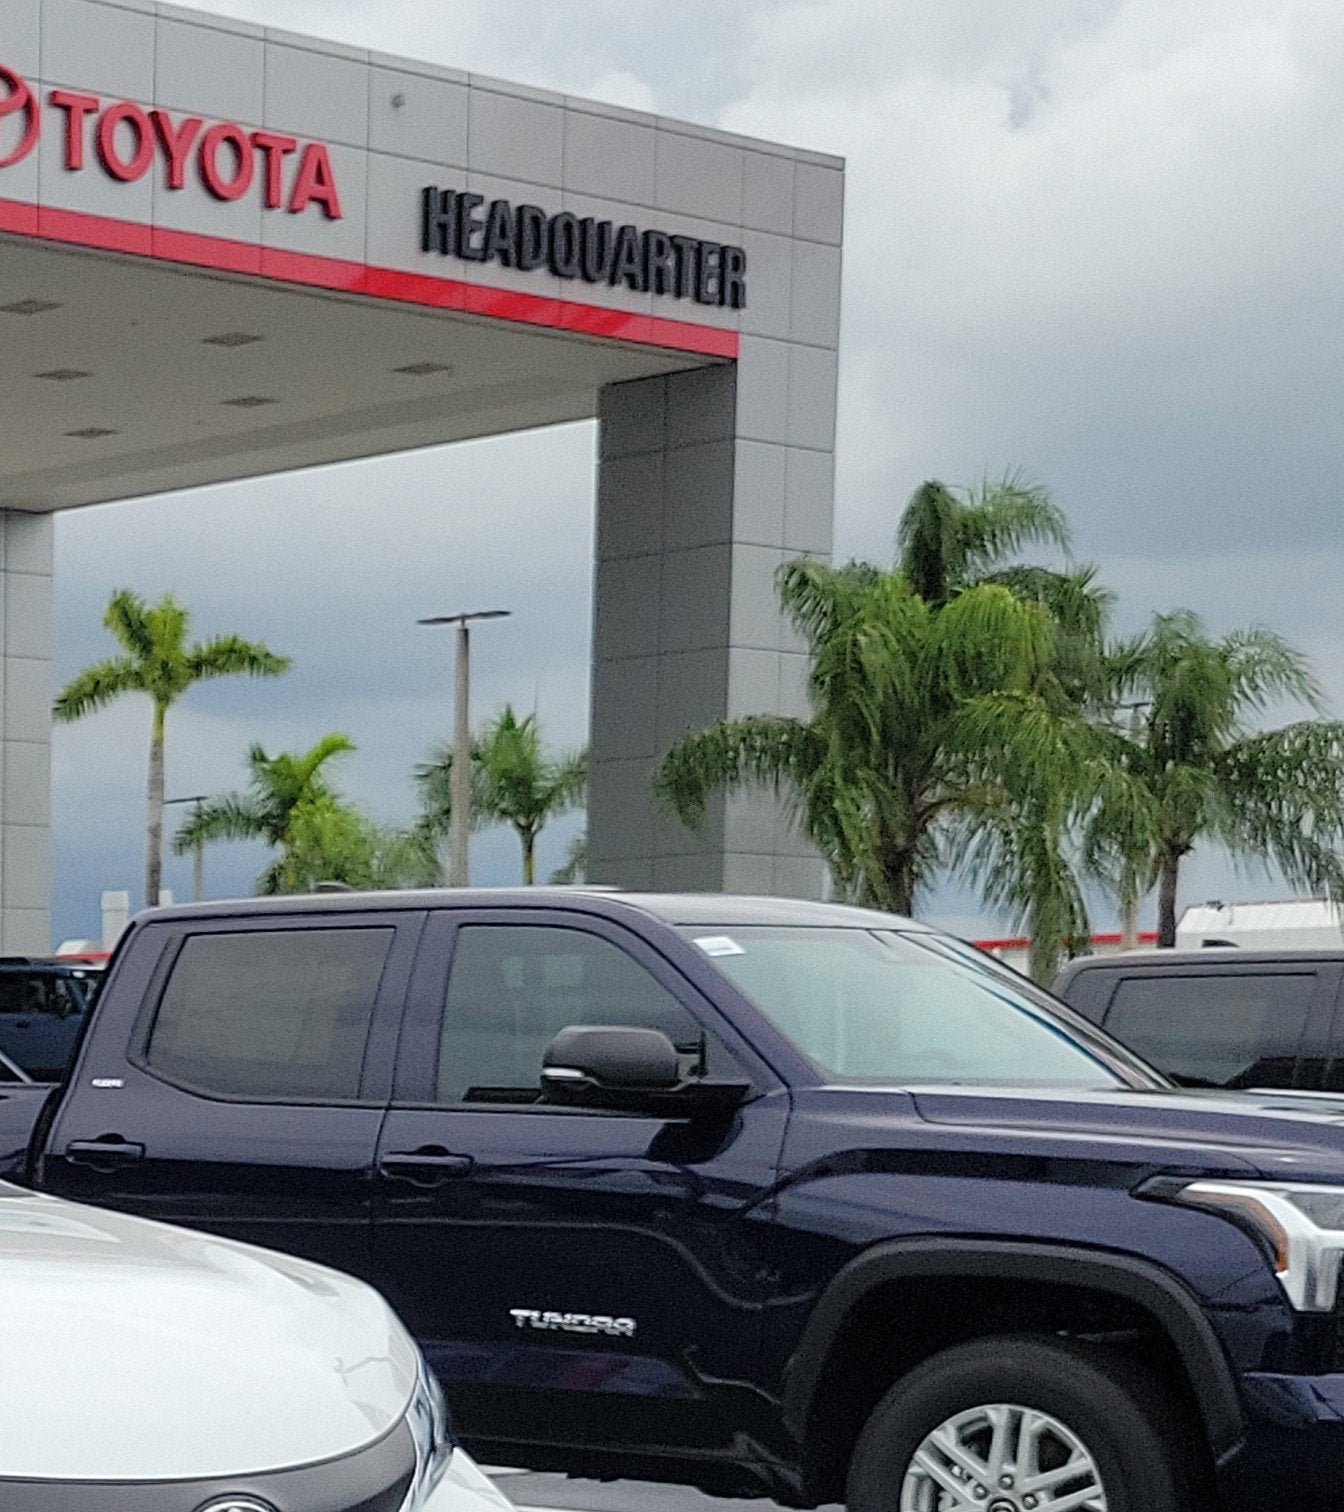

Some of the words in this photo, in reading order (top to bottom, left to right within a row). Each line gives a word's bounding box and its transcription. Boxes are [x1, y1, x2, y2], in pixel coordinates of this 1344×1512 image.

[49, 89, 343, 221] TOYOTA
[420, 186, 747, 310] HEADQUARTER
[509, 1308, 637, 1338] TUNDRA
